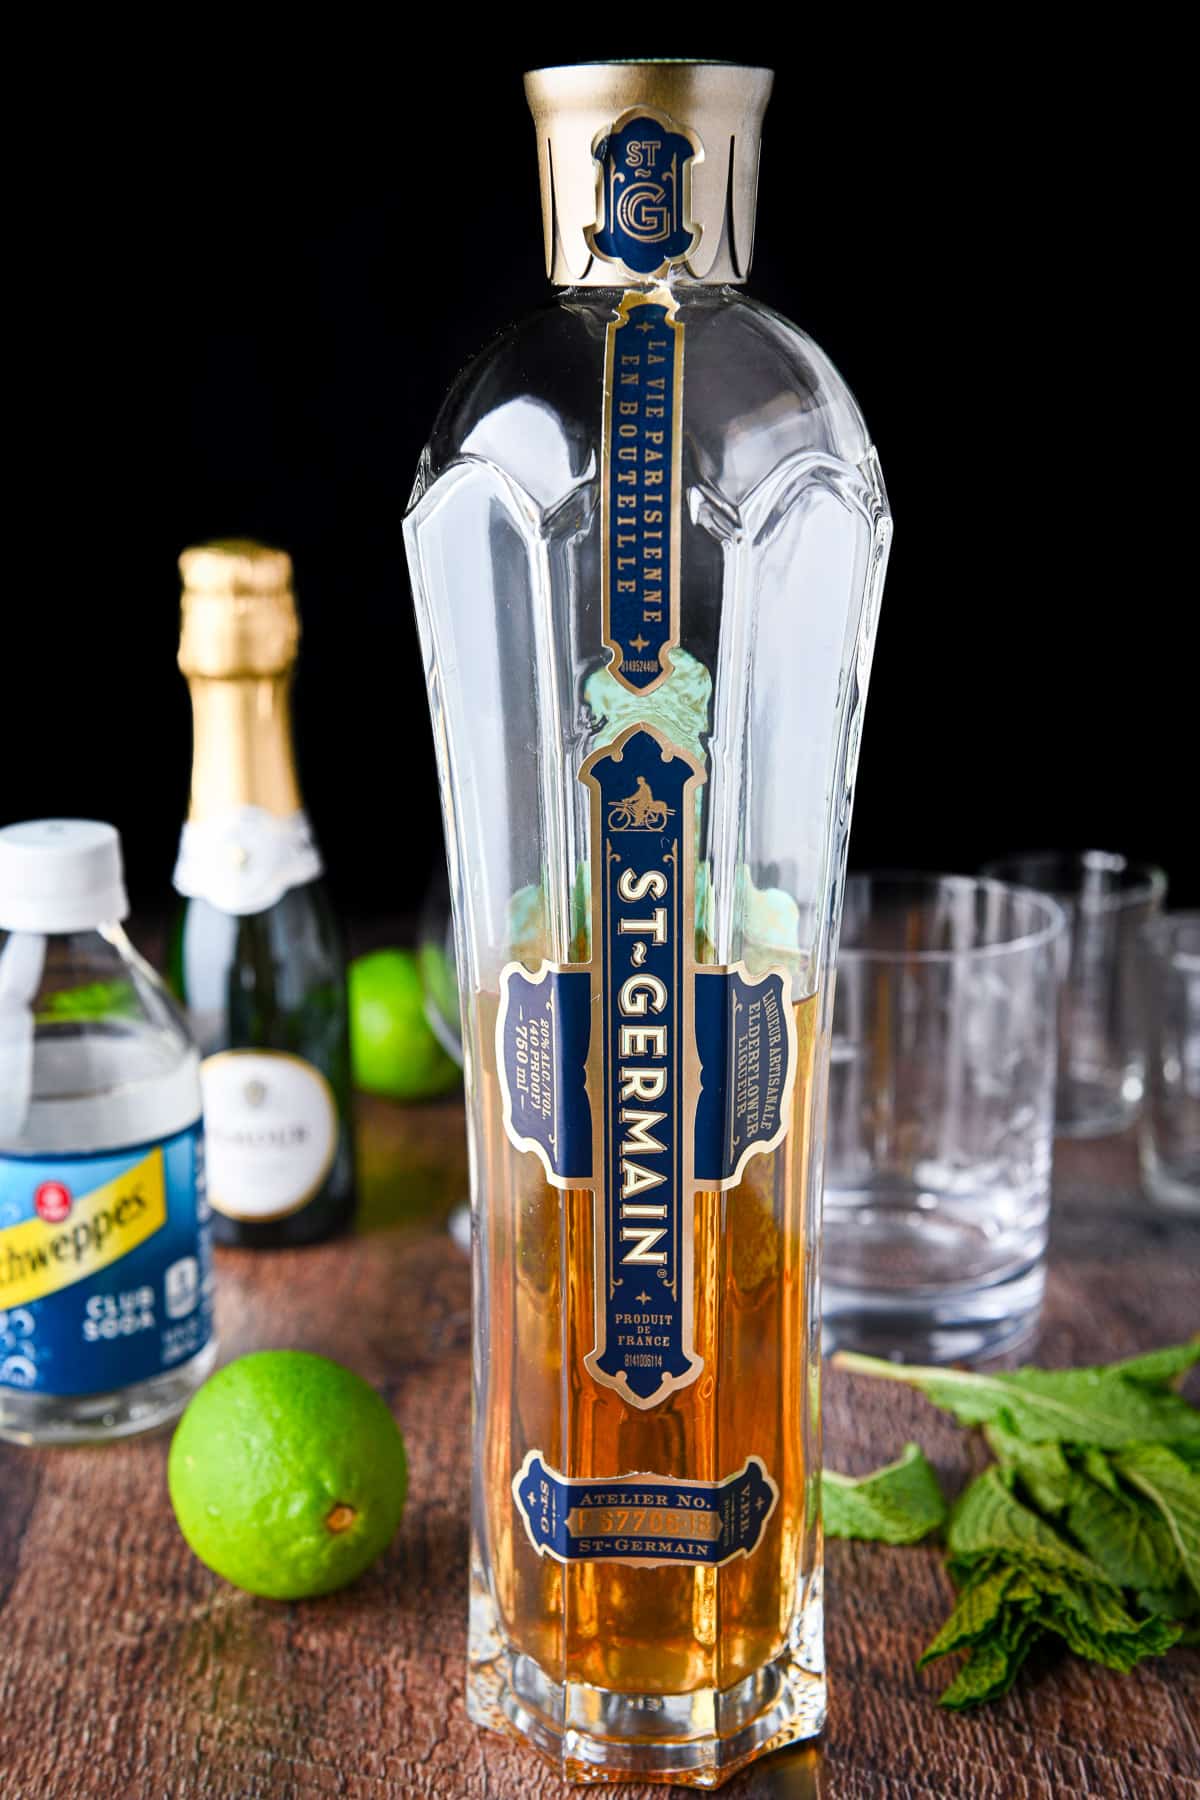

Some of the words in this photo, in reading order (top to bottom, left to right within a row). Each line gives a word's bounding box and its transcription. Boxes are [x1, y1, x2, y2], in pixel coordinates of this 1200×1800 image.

[626, 140, 661, 167] ST
[616, 182, 671, 243] G
[620, 354, 640, 385] EN
[647, 341, 667, 365] LA
[645, 378, 666, 418] VIE
[616, 401, 639, 593] BOUTEILLE
[643, 430, 665, 623] PARISIENNE
[529, 1019, 540, 1047] (40
[762, 988, 781, 1046] LIQUEUR
[515, 1025, 529, 1065] 750
[530, 1048, 542, 1110] PROOF)
[736, 1034, 749, 1118] LIQUEUR
[746, 1000, 761, 1138] ELDERFLOWER
[760, 1047, 782, 1131] ARTISANALE
[0, 1181, 147, 1286] hweppes
[615, 1313, 673, 1325] PRODUIT
[637, 1325, 651, 1334] DE
[617, 1335, 670, 1347] FRANCE
[579, 1492, 669, 1507] ATELIER
[676, 1494, 711, 1509] NO.
[578, 1538, 709, 1556] ST-GERMAIN
